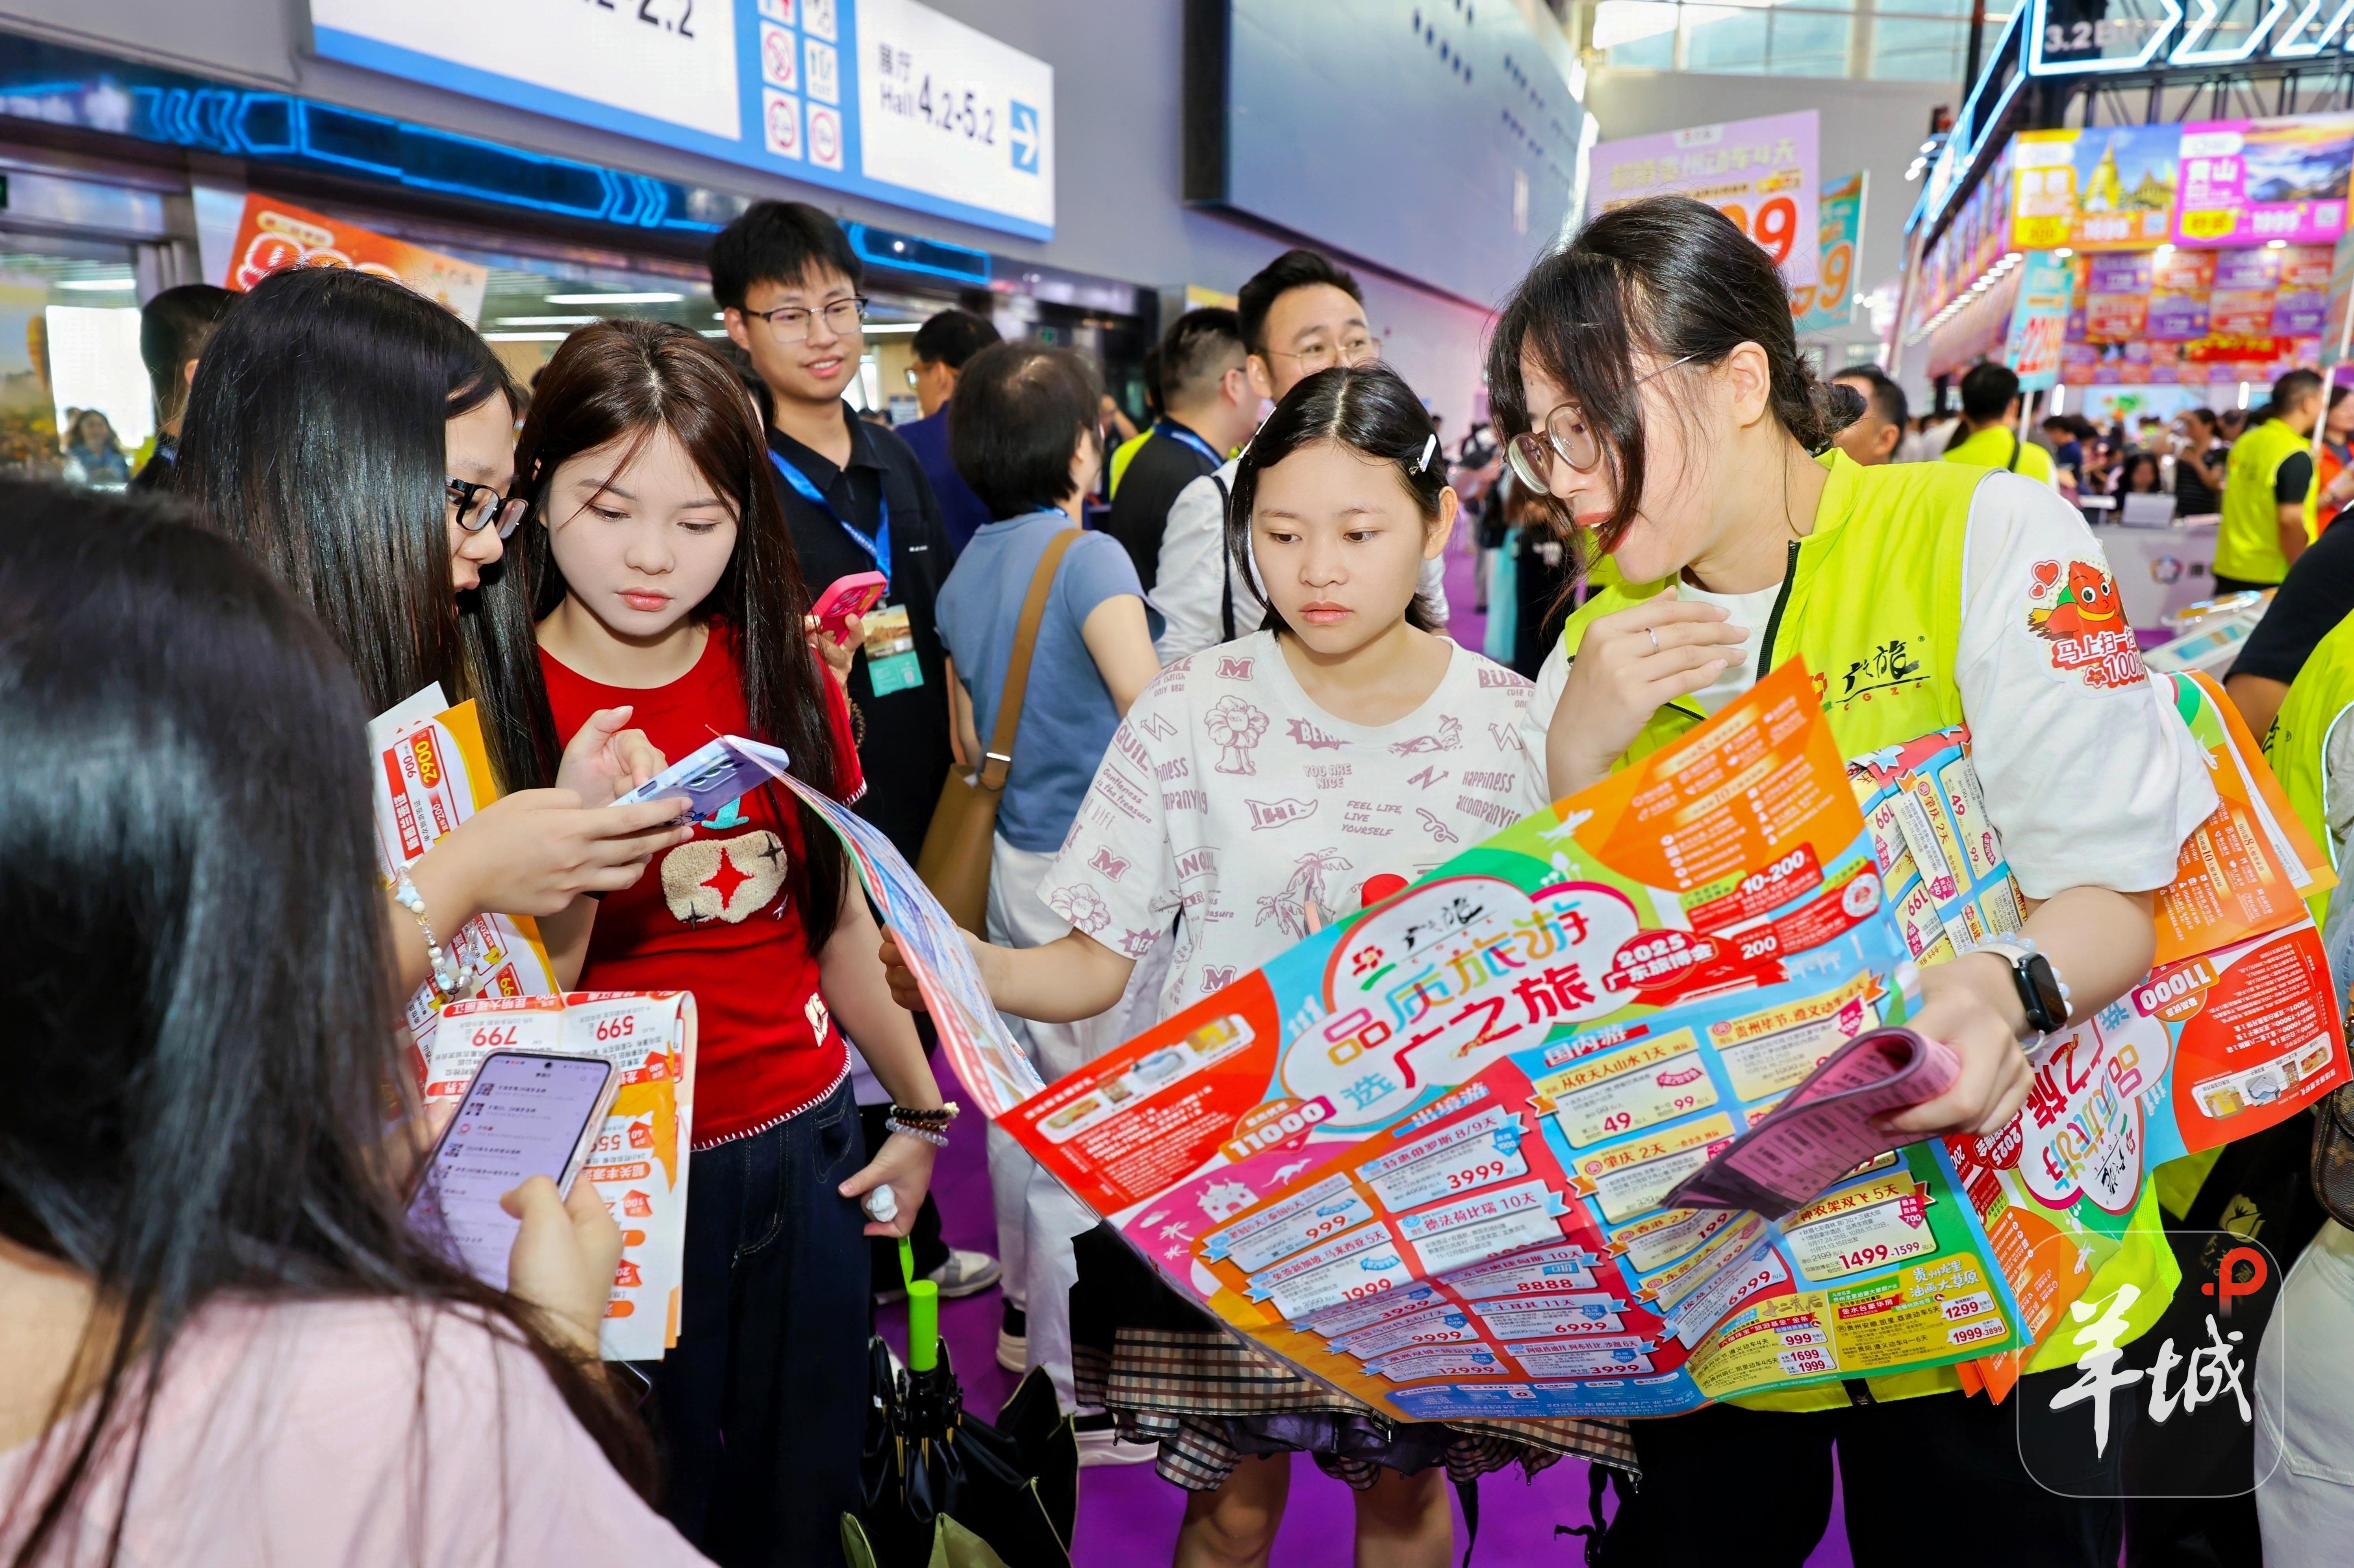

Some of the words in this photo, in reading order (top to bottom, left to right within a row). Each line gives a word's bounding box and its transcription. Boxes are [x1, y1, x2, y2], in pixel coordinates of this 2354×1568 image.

[879, 82, 915, 118] Hall
[403, 755, 417, 778] 900
[415, 740, 437, 784] 2900
[1303, 765, 1328, 777] YOU
[1329, 763, 1352, 776] ARE
[1316, 777, 1344, 789] NICE
[1102, 783, 1119, 798] the
[1116, 793, 1152, 824] treasure
[1347, 800, 1373, 811] FEEL
[1948, 792, 1968, 818] 49
[393, 792, 420, 852] 新西兰签证
[413, 798, 430, 842] 单次旅游签证
[1344, 813, 1369, 823] LIVE
[1922, 795, 1943, 822] 肇庆
[1933, 823, 1952, 845] 2天
[1342, 823, 1394, 837] YOURSELF
[1967, 846, 1981, 863] 99
[1741, 849, 1805, 896] 10-200
[1931, 881, 1943, 896] 130
[1907, 888, 1929, 917] 199
[1616, 933, 1687, 968] 2025
[1740, 936, 1778, 960] 200
[1605, 941, 1713, 991] 广东旅博会
[2139, 963, 2213, 1011] 11000
[452, 997, 527, 1016] 昆明大理丽江
[2164, 998, 2198, 1018] 最高优惠
[470, 1025, 518, 1048] 799
[595, 1014, 635, 1041] 599
[1394, 963, 1595, 1089] 广之旅
[1544, 1024, 1628, 1067] 国内游
[1562, 1055, 1640, 1091] 从化天人山水
[1643, 1046, 1666, 1063] 1天
[1674, 1096, 1694, 1111] 99
[1228, 1102, 1327, 1157] 11000
[1455, 1116, 1498, 1138] 8/9天
[1604, 1113, 1631, 1132] 49
[1603, 1151, 1635, 1169] 肇庆
[1640, 1143, 1666, 1159] 2天
[1991, 1131, 2021, 1165] 2025
[1446, 1160, 1505, 1190] 3999
[624, 1197, 644, 1208] 100
[1424, 1202, 1498, 1232] 德法荷比瑞
[1500, 1191, 1537, 1210] 10天
[1799, 1190, 1869, 1222] 神农架双飞
[1873, 1183, 1899, 1200] 5天
[1901, 1197, 1917, 1207] 最高
[1903, 1205, 1918, 1214] 直降
[1305, 1215, 1347, 1239] 999
[1698, 1213, 1728, 1240] 199
[1904, 1213, 1922, 1224] 700
[1366, 1230, 1386, 1244] 5天
[1912, 1260, 1963, 1283] 贵州龙里
[1341, 1278, 1392, 1301] 1999
[1517, 1279, 1574, 1292] 8888
[1729, 1270, 1772, 1306] 6999
[1909, 1269, 1980, 1299] 油画大草原
[1379, 1300, 1429, 1318] 3999
[1841, 1298, 1893, 1315] 金水台豪华房
[1944, 1301, 1979, 1318] 1299
[1411, 1331, 1462, 1342] 9999
[1555, 1322, 1607, 1333] 6999
[1952, 1325, 2003, 1343] 1999-3899
[1785, 1333, 1811, 1346] 999
[1790, 1349, 1819, 1362] 1699
[1798, 1360, 1825, 1372] 1999
[1437, 1366, 1495, 1375] 12999
[1590, 1364, 1640, 1374] 3999
